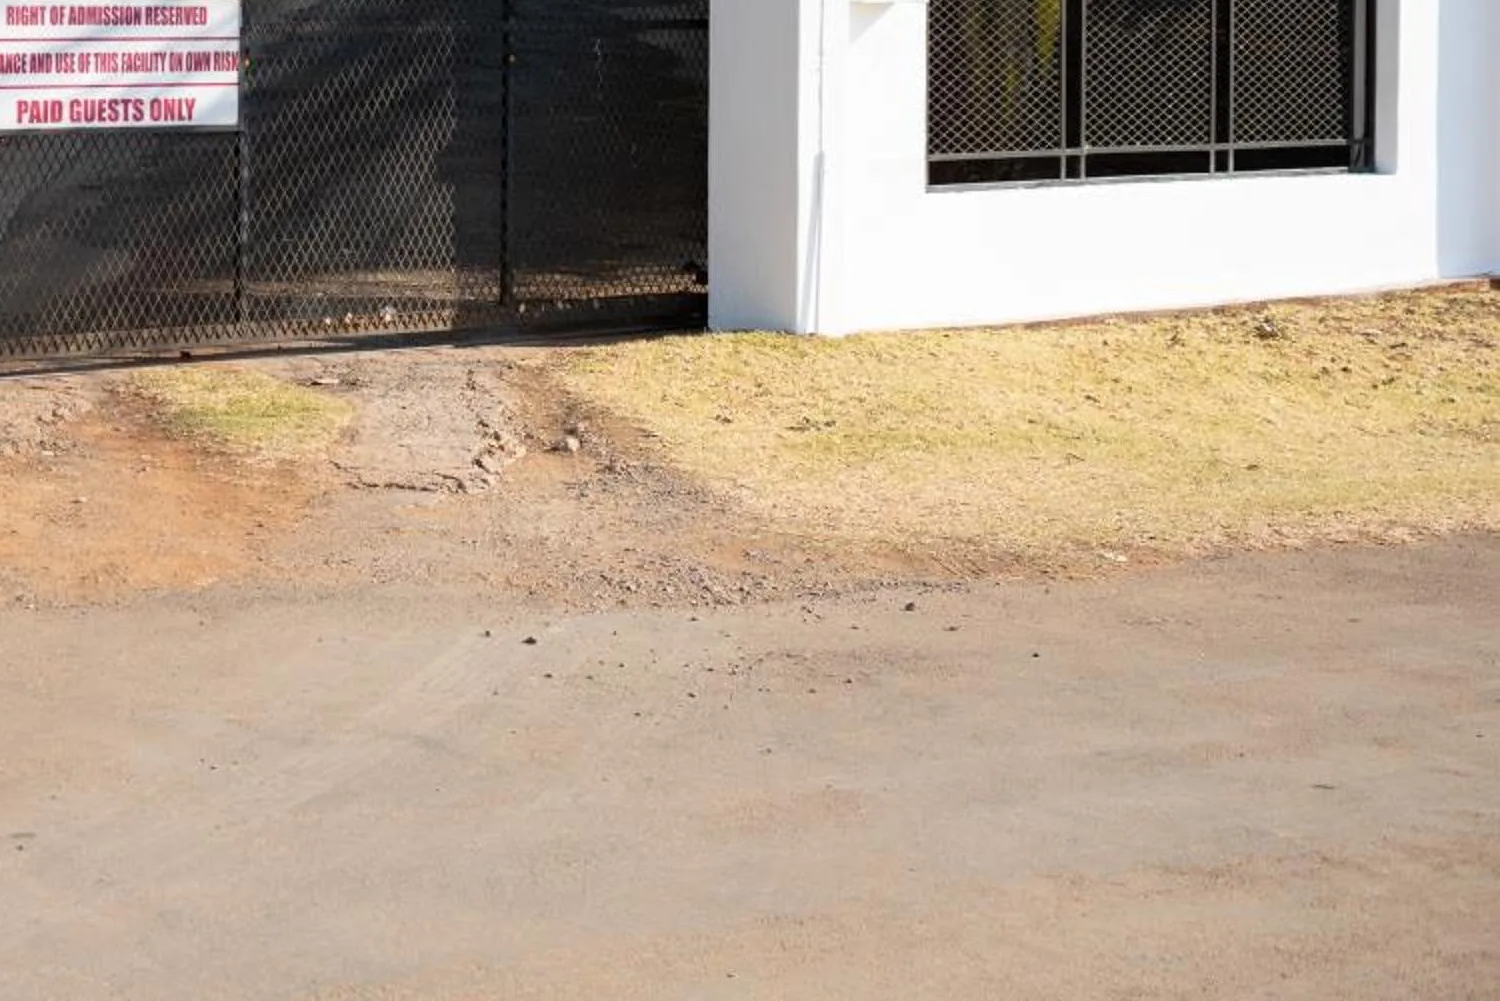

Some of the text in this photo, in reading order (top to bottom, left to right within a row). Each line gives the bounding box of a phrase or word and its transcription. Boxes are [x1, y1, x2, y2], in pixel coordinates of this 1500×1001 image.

[6, 6, 208, 26] RIGHT OF ADMISSION RESERVED
[29, 53, 52, 74] AND
[55, 52, 76, 73] USE
[78, 52, 91, 73] OF
[94, 52, 119, 73] THIS
[121, 51, 167, 72] FACILITY
[169, 51, 182, 72] ON
[186, 51, 210, 71] OWN
[213, 50, 239, 71] RISK
[16, 98, 197, 123] PAID GUESTS ONLY
